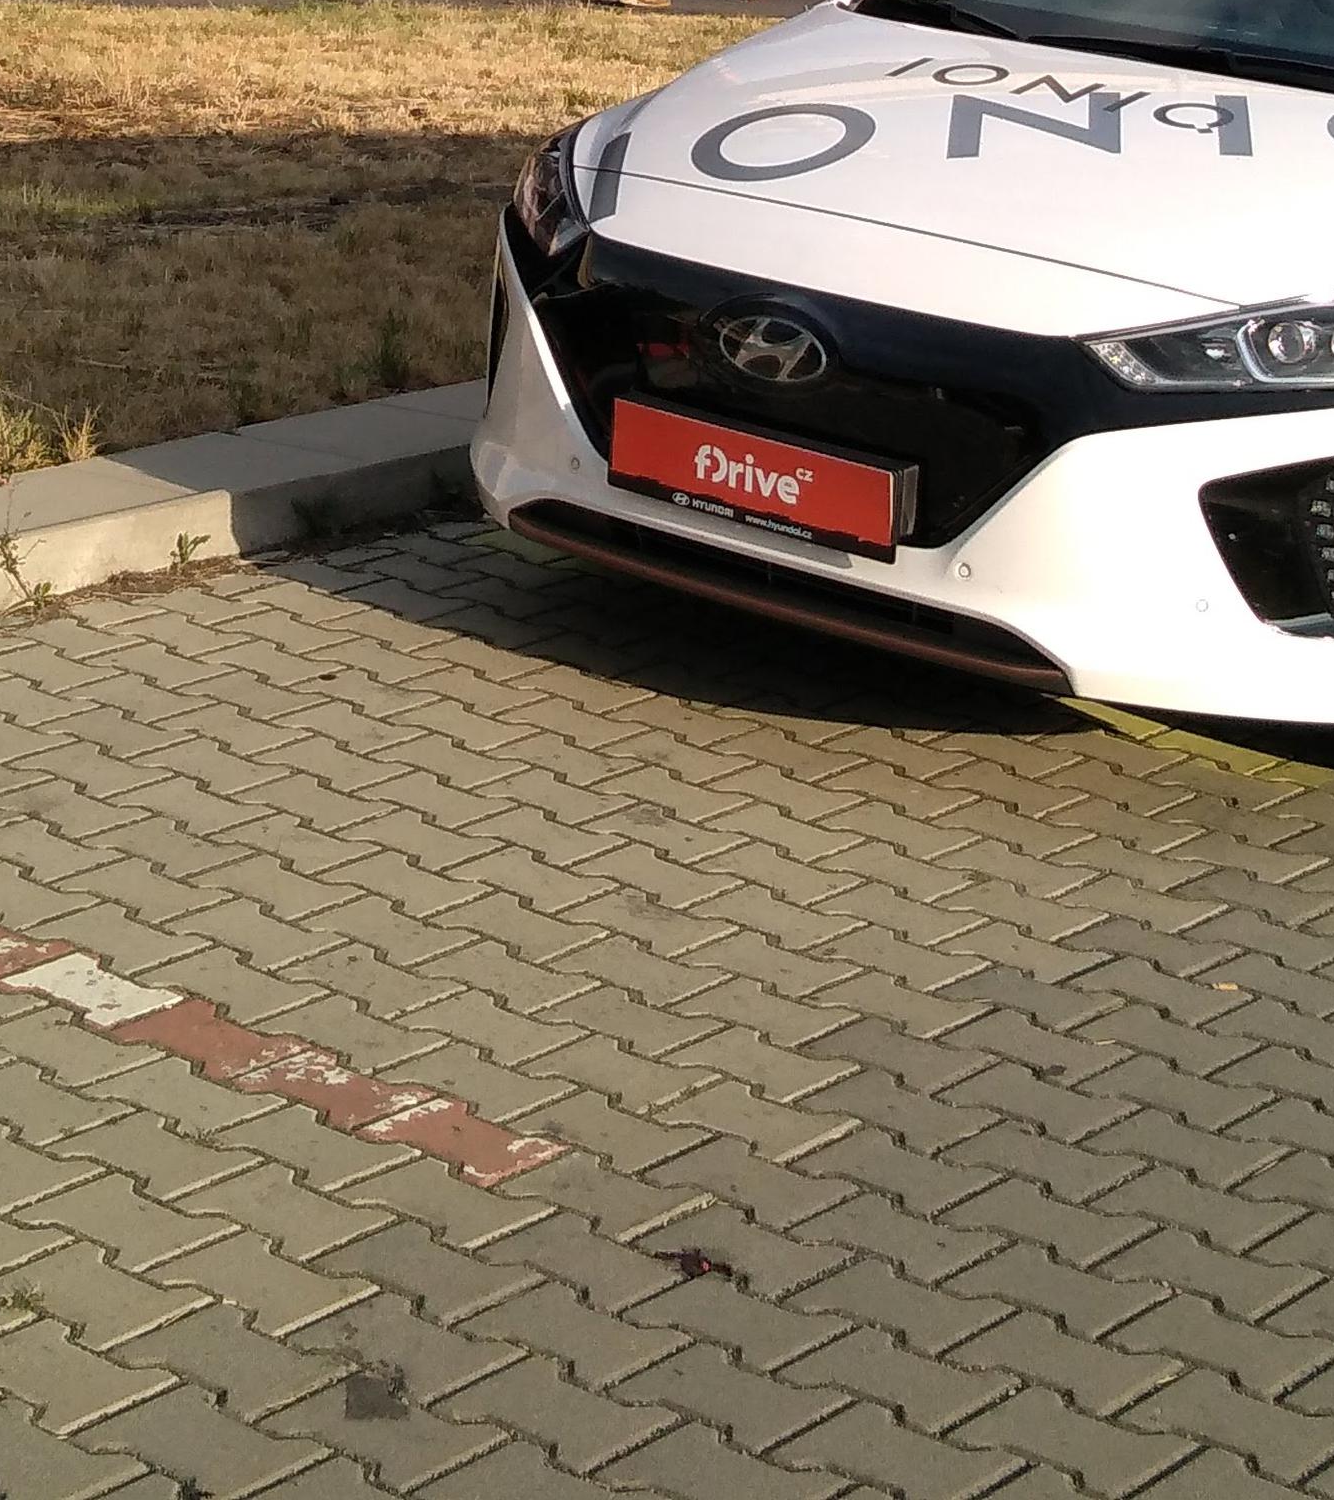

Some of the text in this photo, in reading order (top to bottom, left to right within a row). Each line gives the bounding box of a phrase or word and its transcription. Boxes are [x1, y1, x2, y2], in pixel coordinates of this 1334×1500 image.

[886, 57, 1234, 135] IONIQ
[692, 498, 813, 539] HYUNDAI www.hyundai.cz
